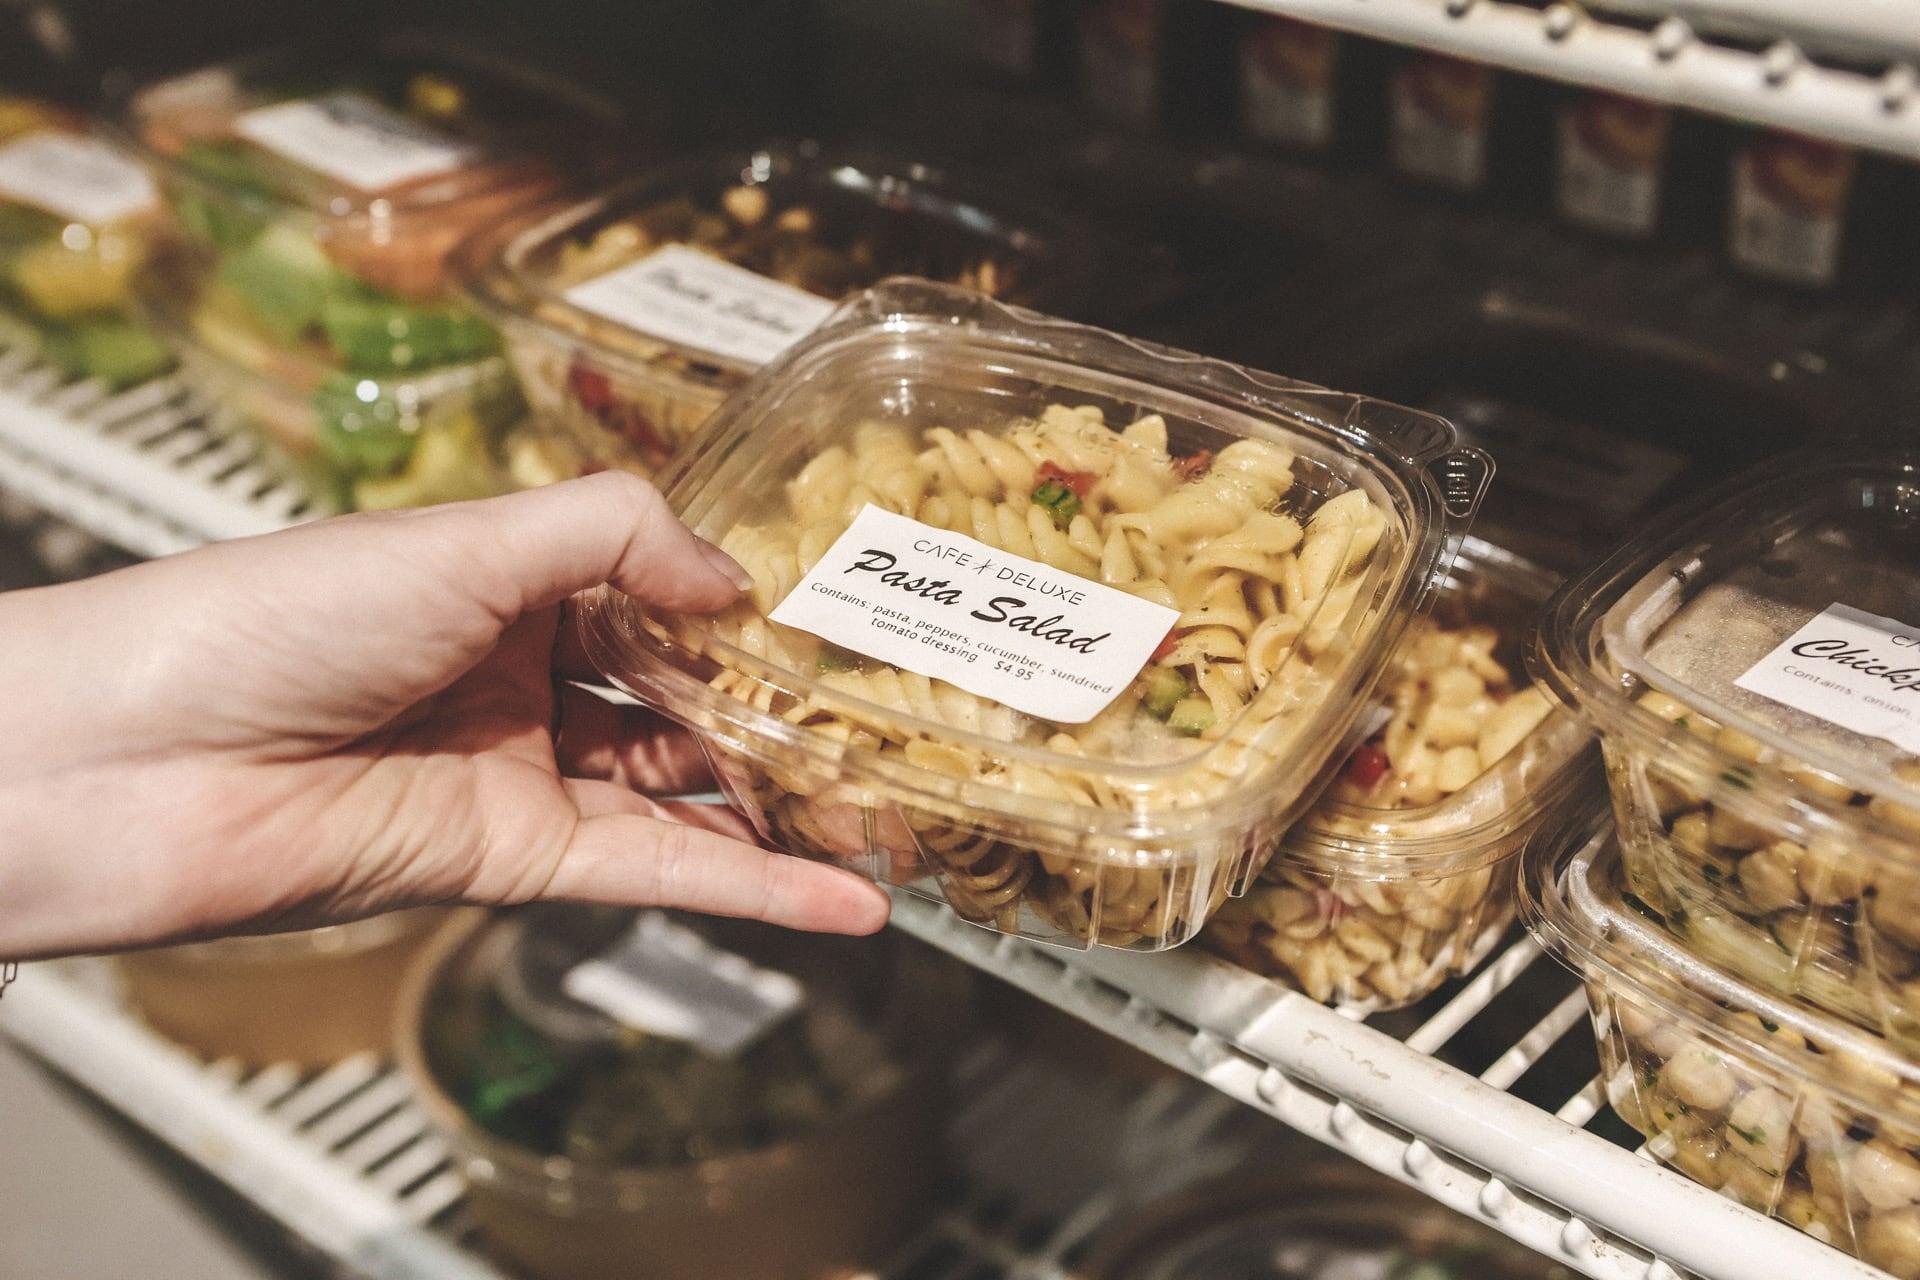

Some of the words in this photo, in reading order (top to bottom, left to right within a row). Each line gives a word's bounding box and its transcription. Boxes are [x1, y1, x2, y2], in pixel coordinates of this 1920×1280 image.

[843, 549, 962, 605] Pasta
[970, 597, 1111, 653] Salad
[914, 540, 973, 566] CAFE
[996, 567, 1086, 605] DELUXE
[811, 582, 872, 609] Contains:
[872, 604, 911, 625] pasta,
[915, 619, 971, 647] peppers,
[977, 641, 1044, 673] cucumber,
[1051, 668, 1113, 694] sundried
[871, 617, 918, 640] tomato
[921, 636, 978, 663] dressing
[994, 661, 1035, 681] $4.95
